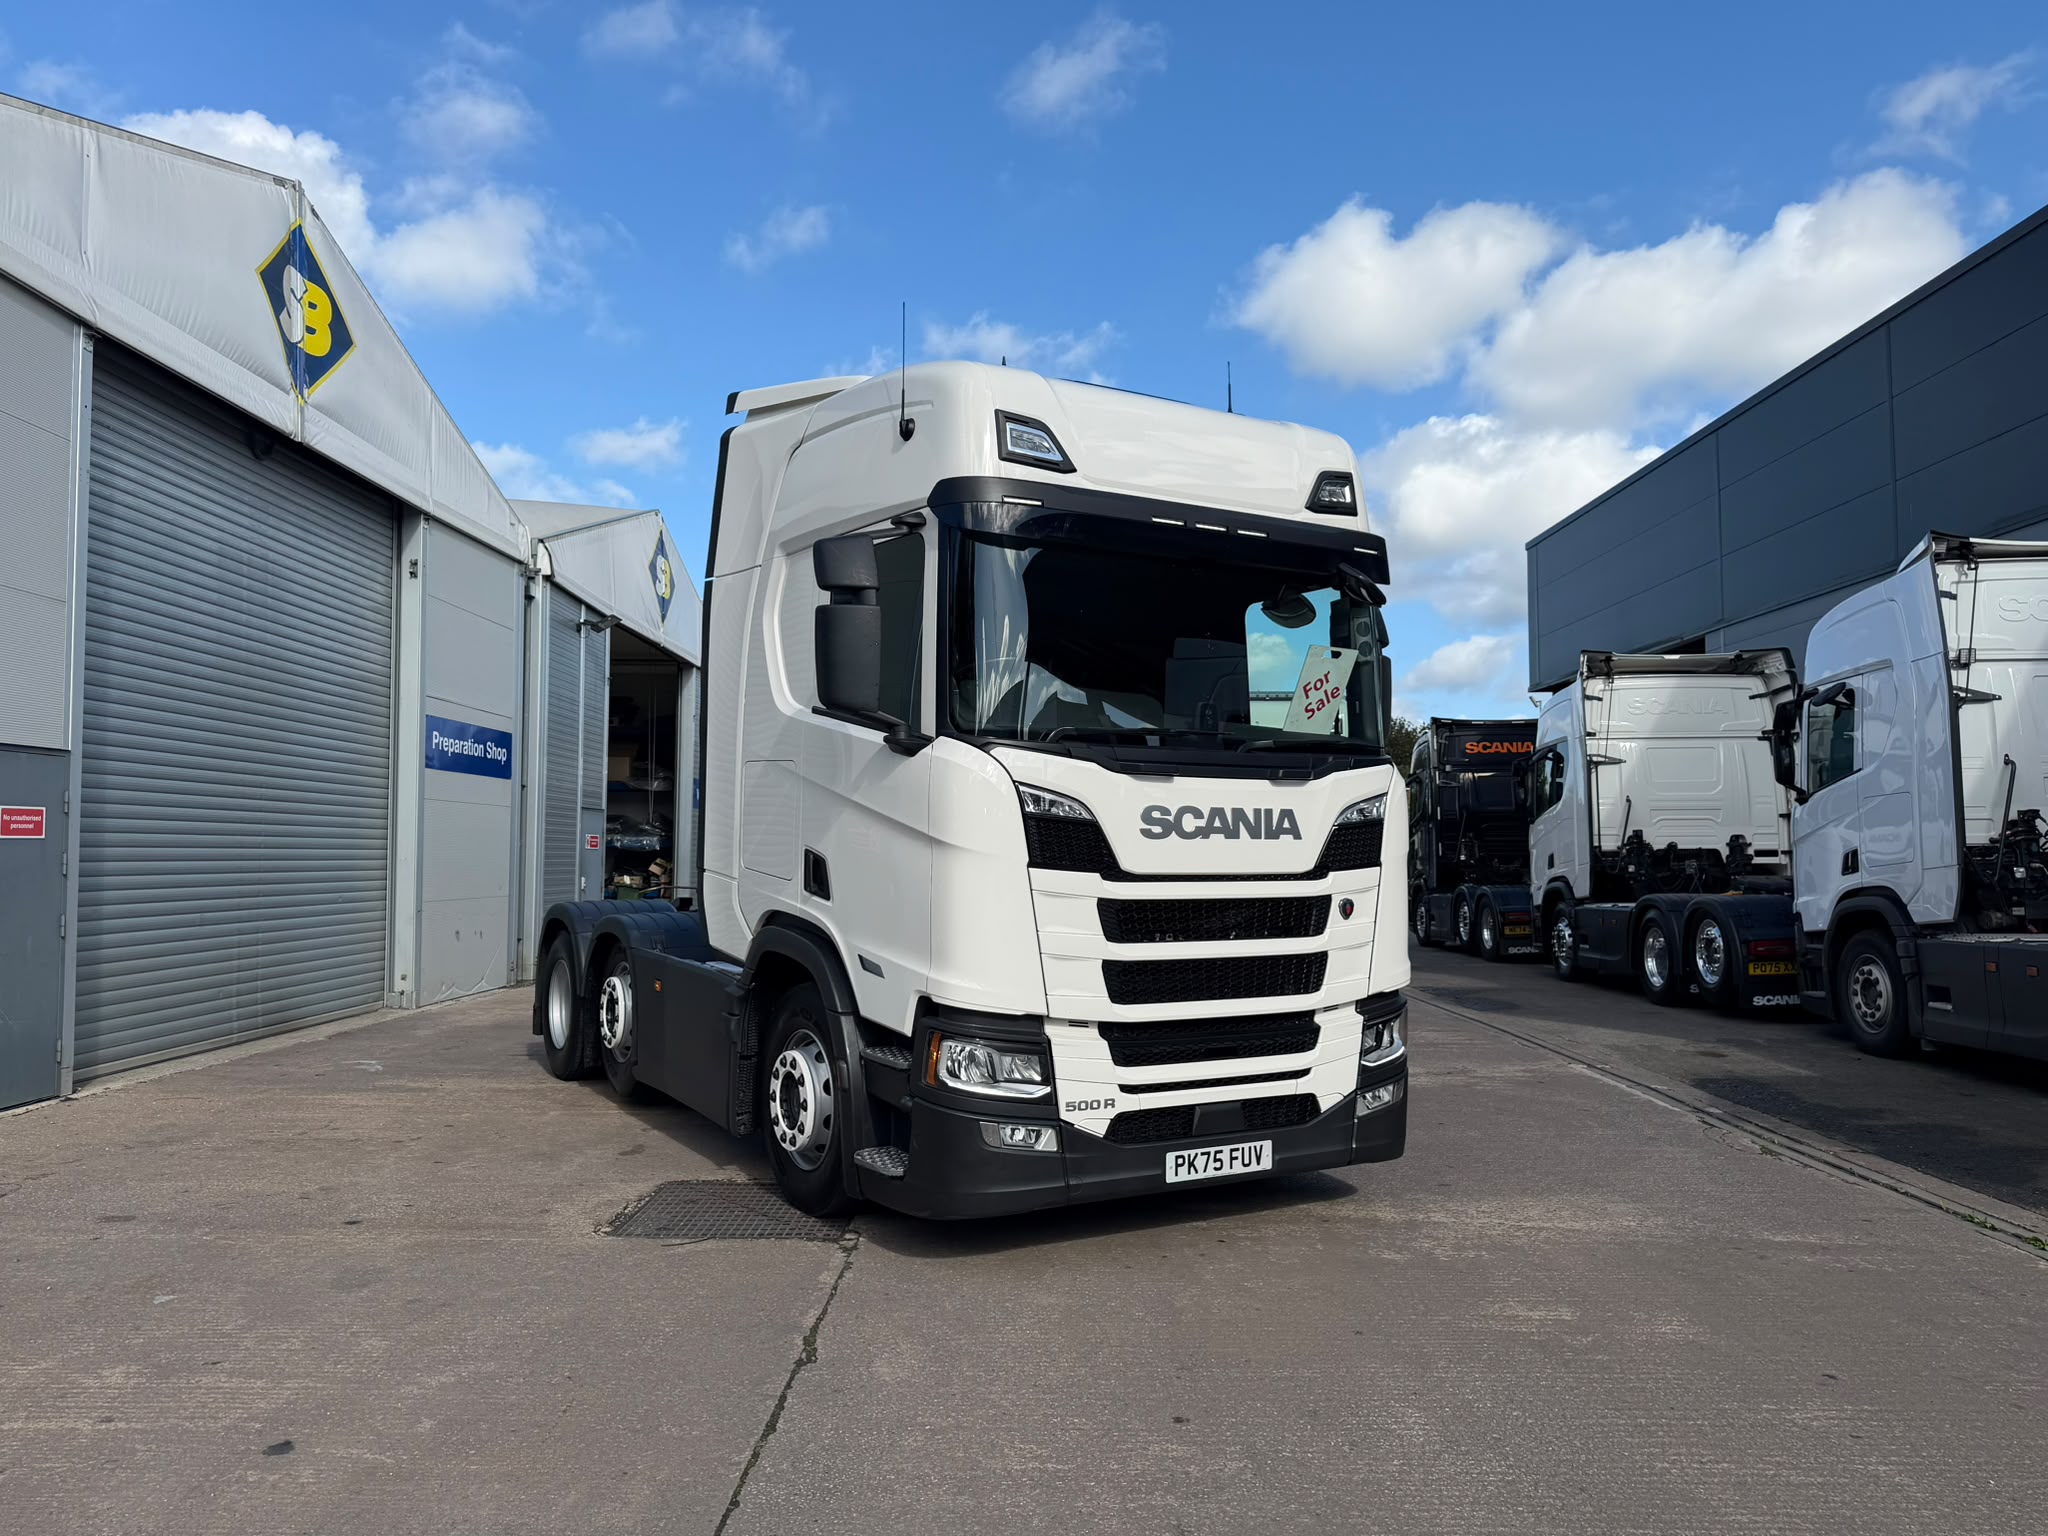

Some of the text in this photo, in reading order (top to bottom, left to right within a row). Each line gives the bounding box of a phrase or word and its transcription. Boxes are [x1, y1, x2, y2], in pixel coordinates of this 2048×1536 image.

[1302, 670, 1330, 700] For
[1304, 686, 1341, 720] Sale
[1627, 697, 1729, 716] SCANIA
[432, 730, 508, 765] Preparation Shop
[1465, 741, 1534, 754] SCANIA
[1139, 804, 1303, 840] SCANIA
[1508, 946, 1535, 954] SCAN
[1065, 1098, 1116, 1112] 500 R
[1174, 1144, 1264, 1177] PK75 FUV
